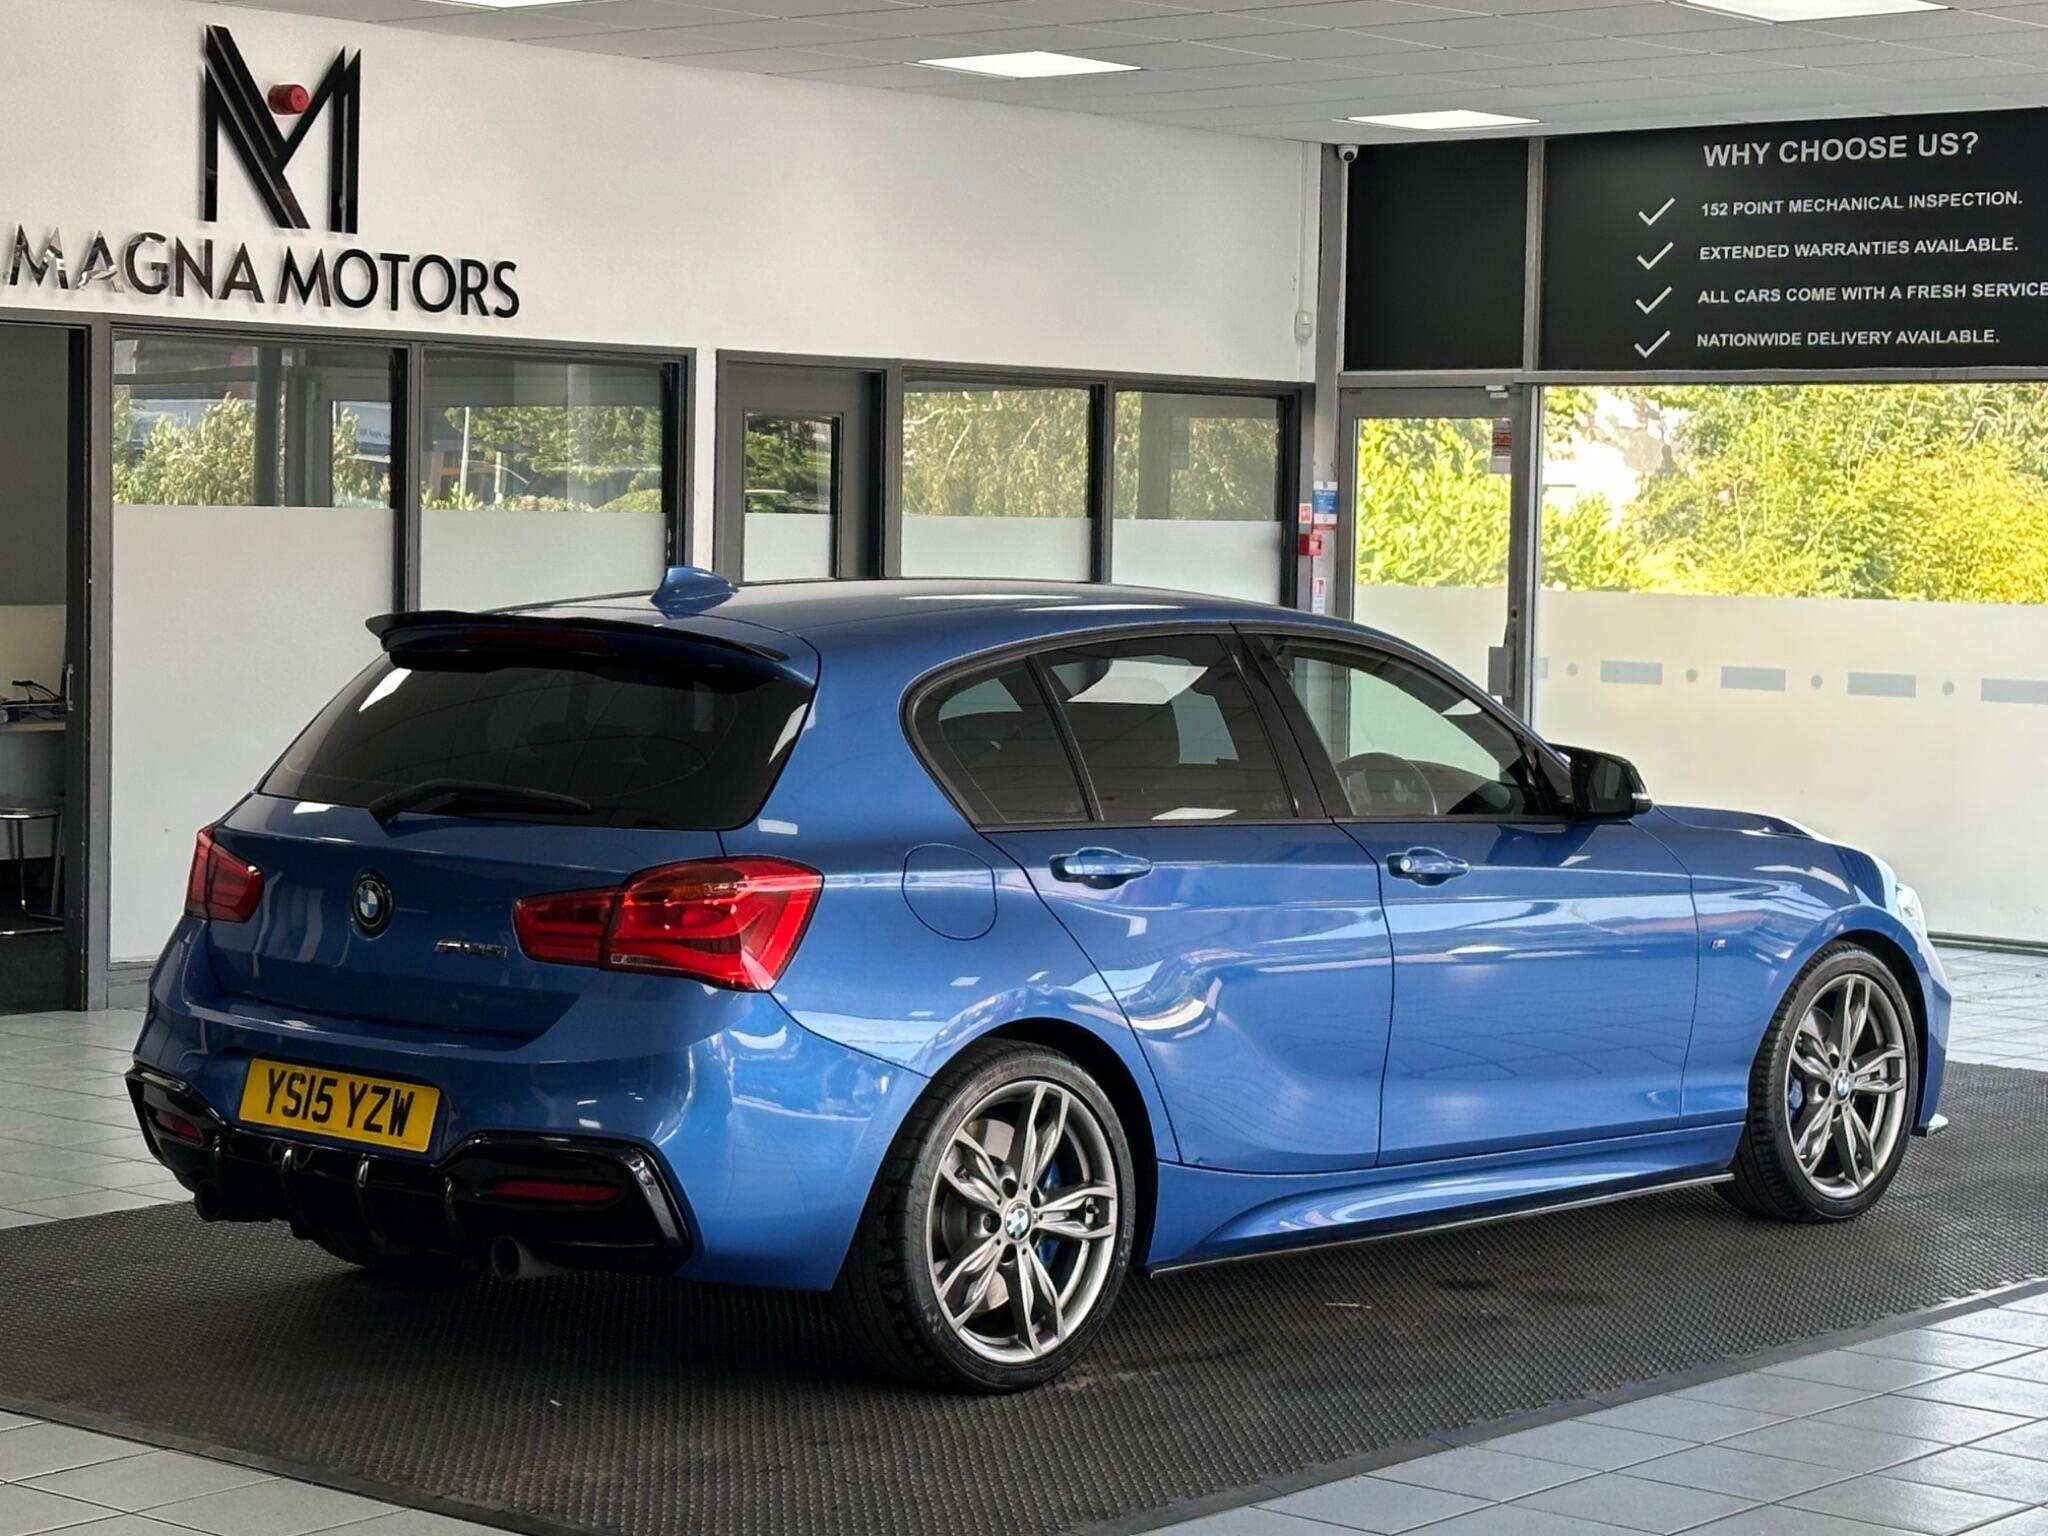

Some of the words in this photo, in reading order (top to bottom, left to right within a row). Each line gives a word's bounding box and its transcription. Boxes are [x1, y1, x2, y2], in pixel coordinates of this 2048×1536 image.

[1703, 141, 1771, 167] WHY
[1778, 134, 1908, 164] CHOOSE
[1918, 131, 1979, 157] US?
[1701, 202, 1729, 217] 152
[1732, 200, 1784, 215] POINT
[1788, 195, 1904, 214] MECHANICAL
[1908, 190, 2023, 209] INSPECTION.
[1700, 244, 1789, 260] EXTENDED
[1794, 240, 1910, 258] WARRANTIES
[1914, 236, 2019, 254] AVAILABLE.
[8, 224, 265, 304] MAGNA
[278, 246, 520, 319] MOTORS
[1698, 289, 1730, 304] ALL
[1734, 288, 1781, 303] CARS
[1786, 287, 1837, 302] COME
[1841, 285, 1886, 301] WITH
[1889, 285, 1902, 299] A
[1907, 283, 1966, 299] FRESH
[1971, 281, 2048, 298] SERVICE
[1697, 332, 1802, 347] NATIONWIDE
[1807, 330, 1892, 346] DELIVERY
[1895, 329, 2000, 345] AVAILABLE.
[266, 1068, 338, 1124] YS15
[346, 1081, 415, 1137] YZW
